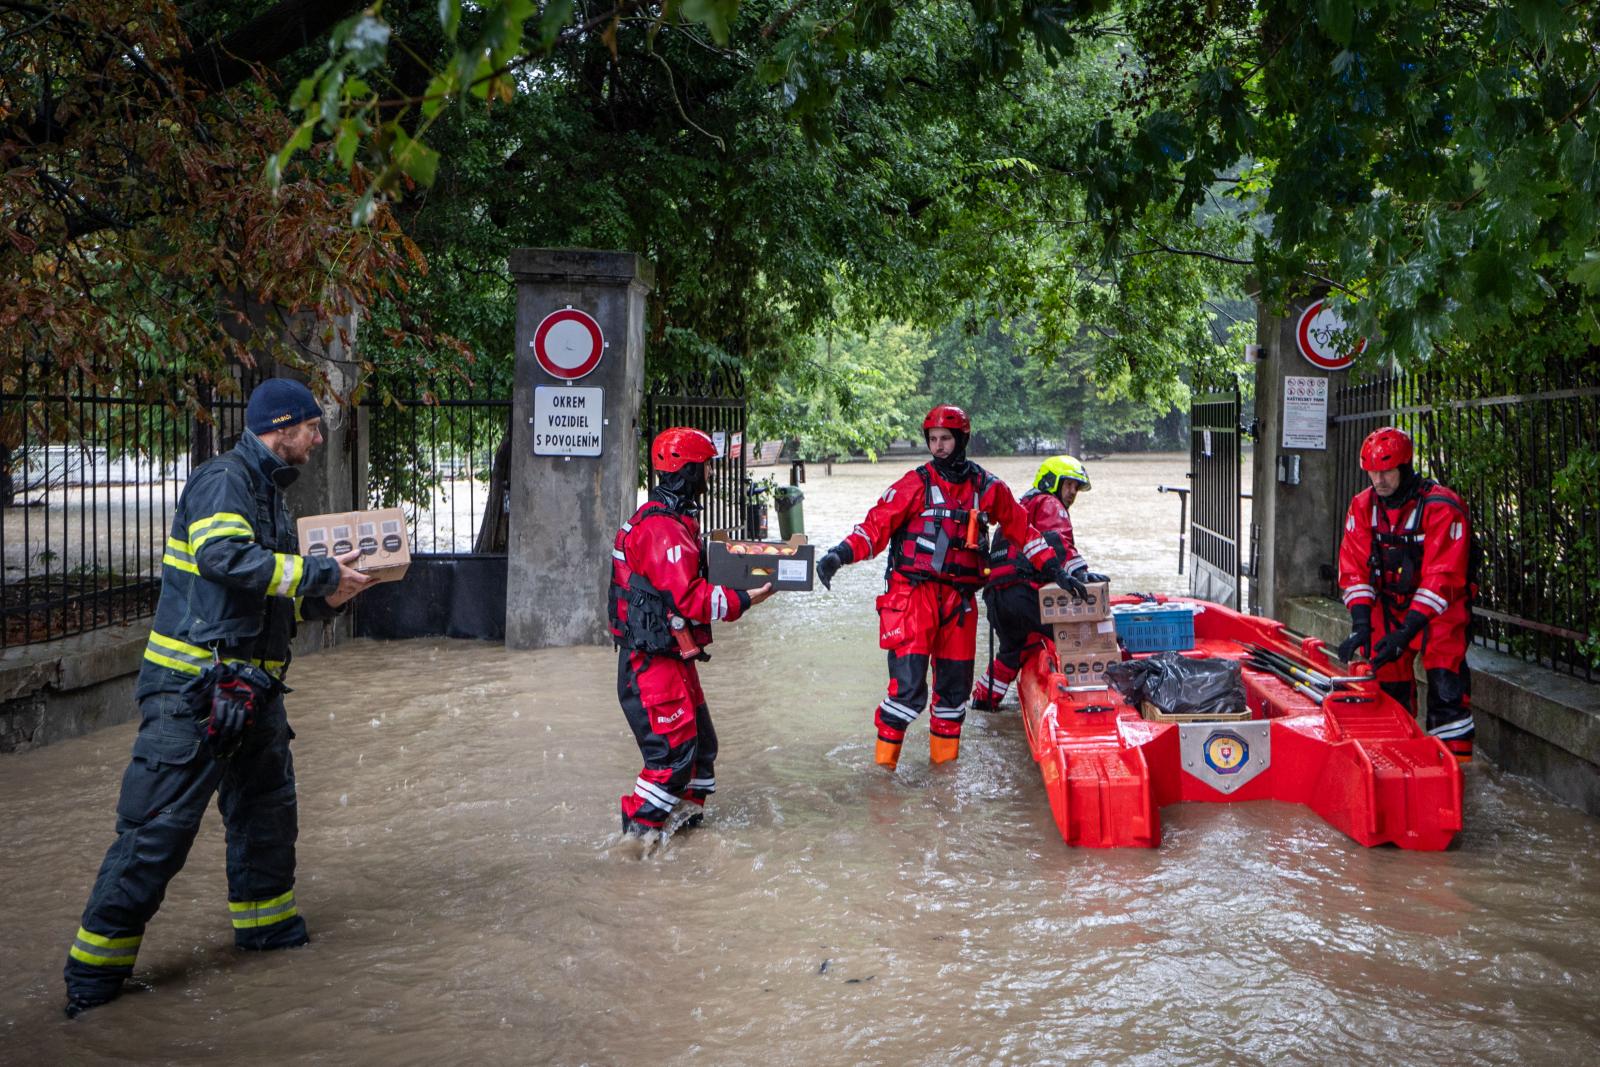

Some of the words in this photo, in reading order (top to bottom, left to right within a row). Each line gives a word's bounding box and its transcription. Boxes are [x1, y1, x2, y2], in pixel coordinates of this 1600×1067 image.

[553, 396, 585, 408] OKREM
[548, 415, 589, 428] VOZIDIEL
[536, 434, 542, 446] S
[545, 432, 599, 447] POVOLENÍM
[657, 708, 684, 724] RESCUE
